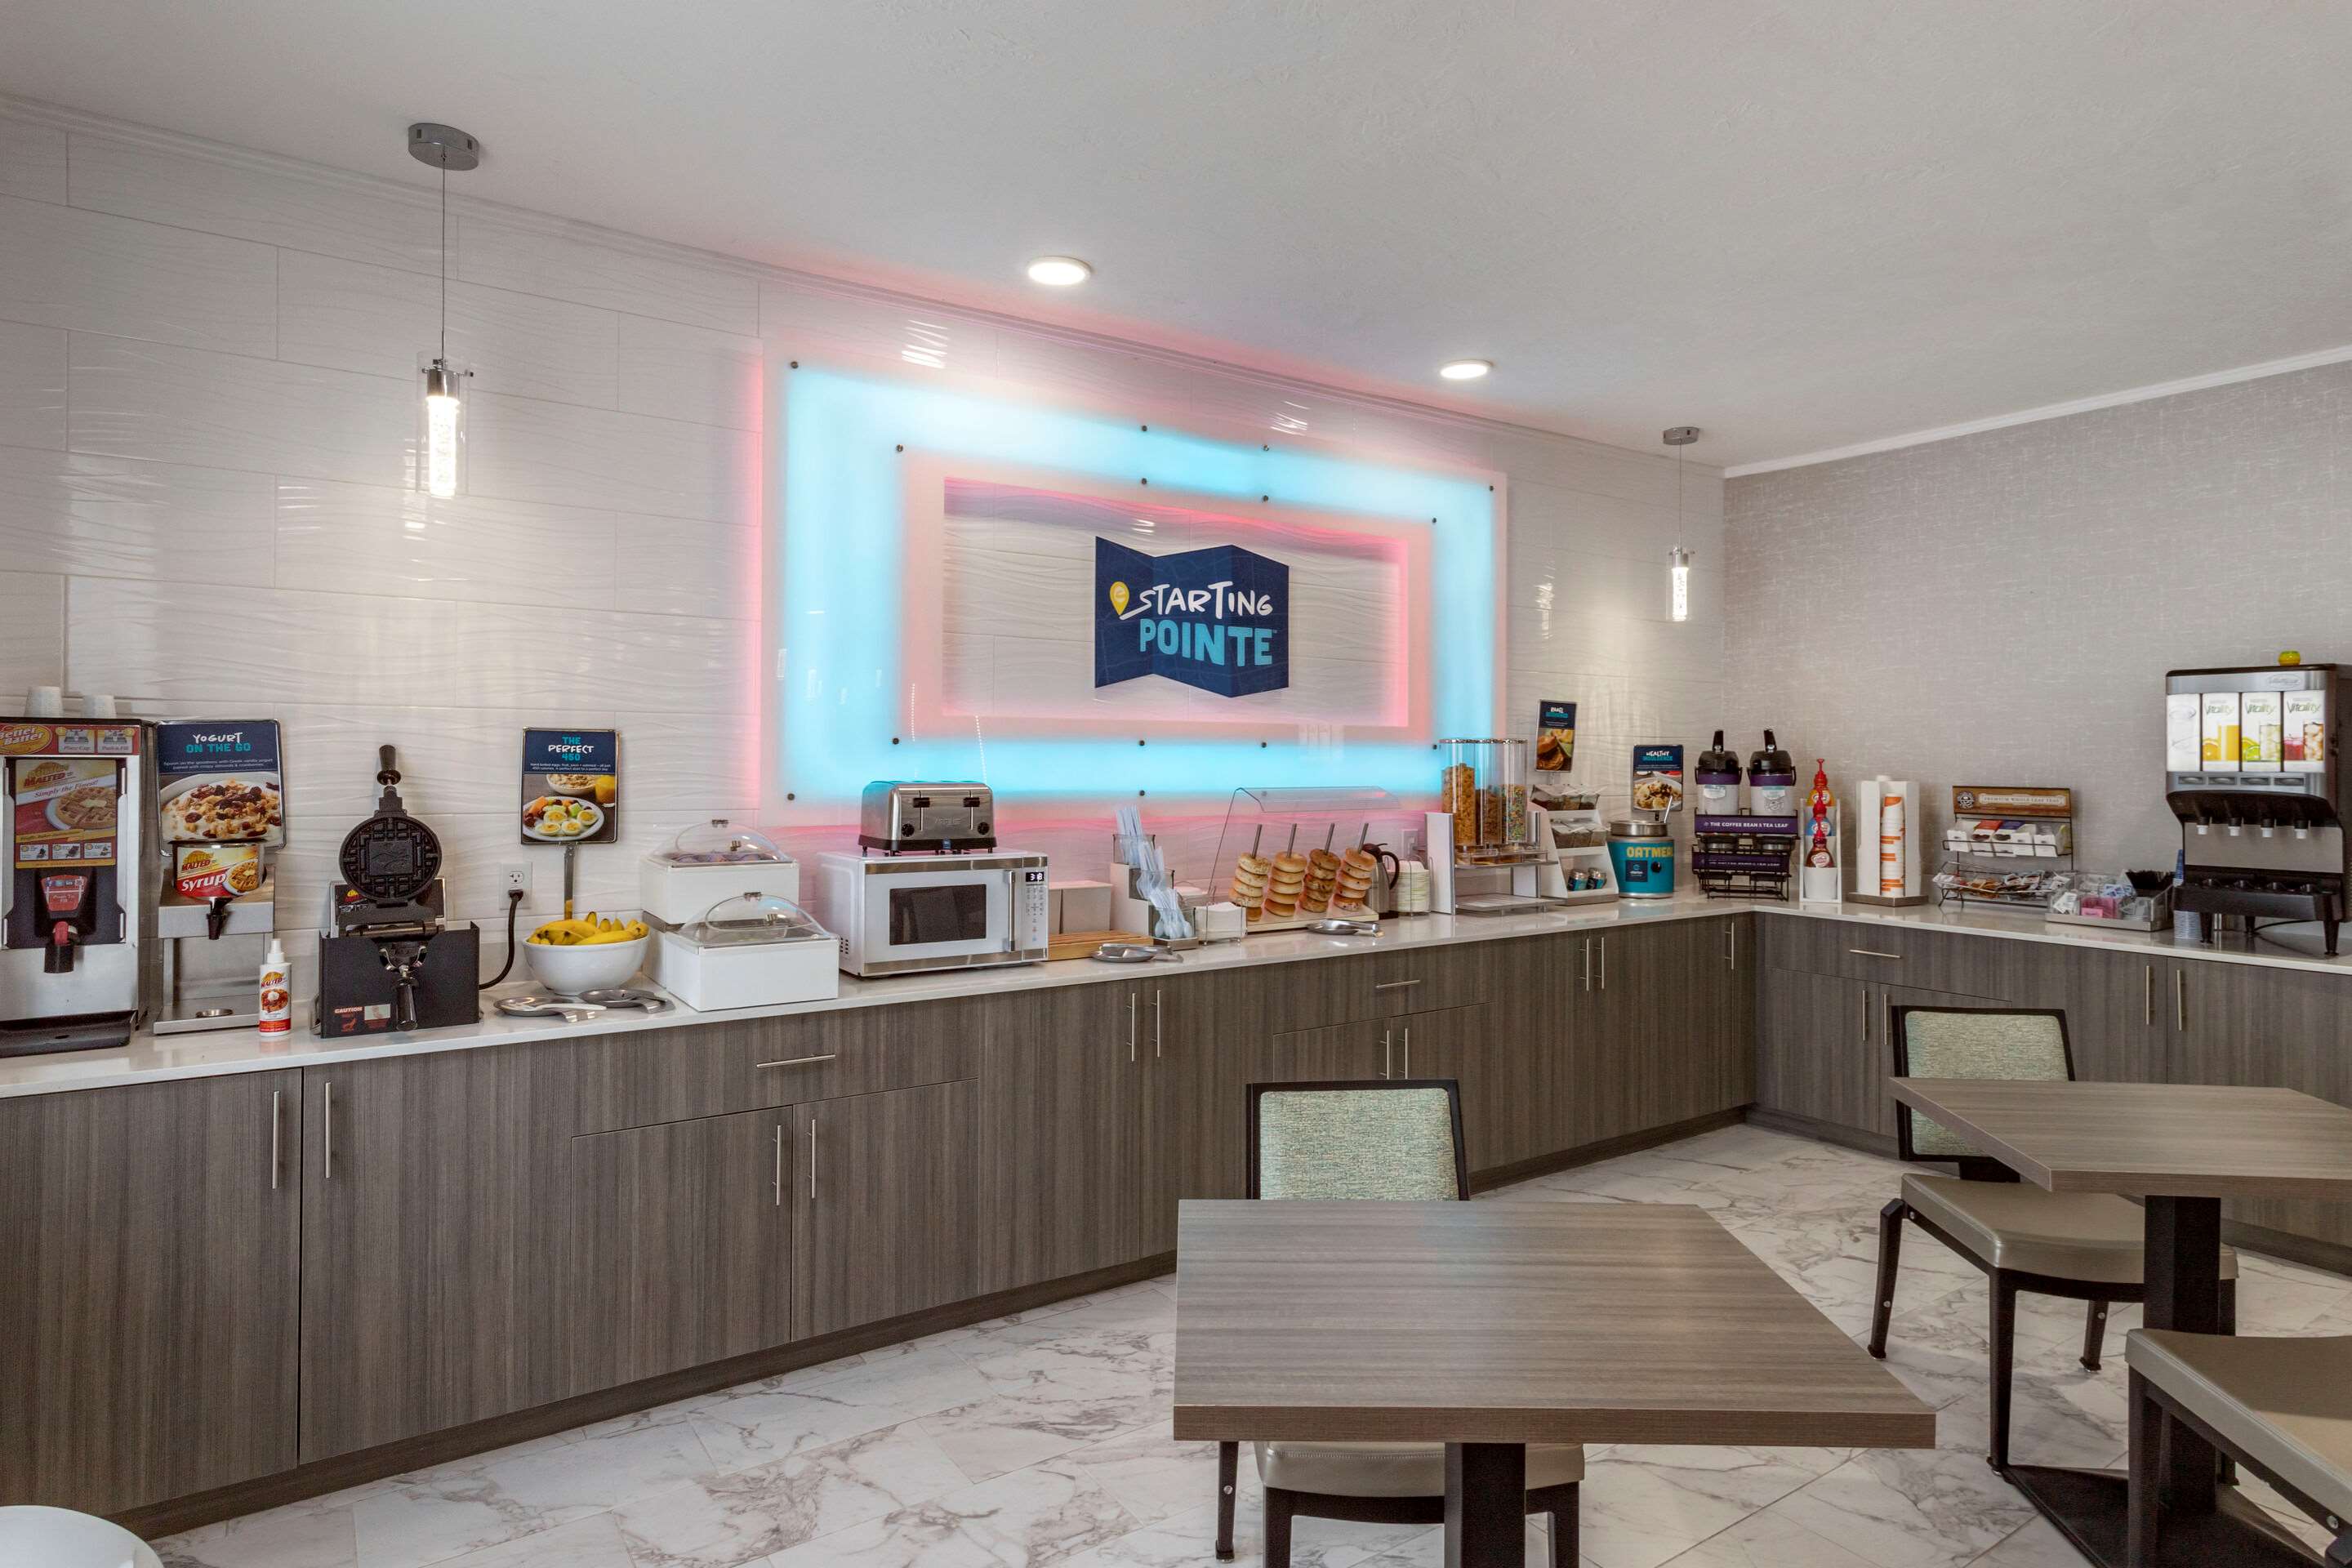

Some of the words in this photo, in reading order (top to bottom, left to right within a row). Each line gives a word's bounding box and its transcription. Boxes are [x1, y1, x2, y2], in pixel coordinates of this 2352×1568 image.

[1119, 581, 1273, 620] STARTING
[1140, 618, 1273, 666] POINTE
[2204, 702, 2235, 715] Vitality
[2246, 702, 2275, 715] Vitality
[2287, 700, 2320, 714] Vitality
[193, 732, 243, 744] YOGURT
[562, 737, 581, 745] THE
[185, 744, 203, 753] ON
[207, 743, 231, 752] THE
[234, 742, 251, 752] GO
[548, 744, 594, 753] PERFECT
[24, 772, 66, 787] MALTED
[34, 786, 60, 799] Simply
[1626, 846, 1673, 858] OATMEA
[181, 873, 226, 892] Syrup
